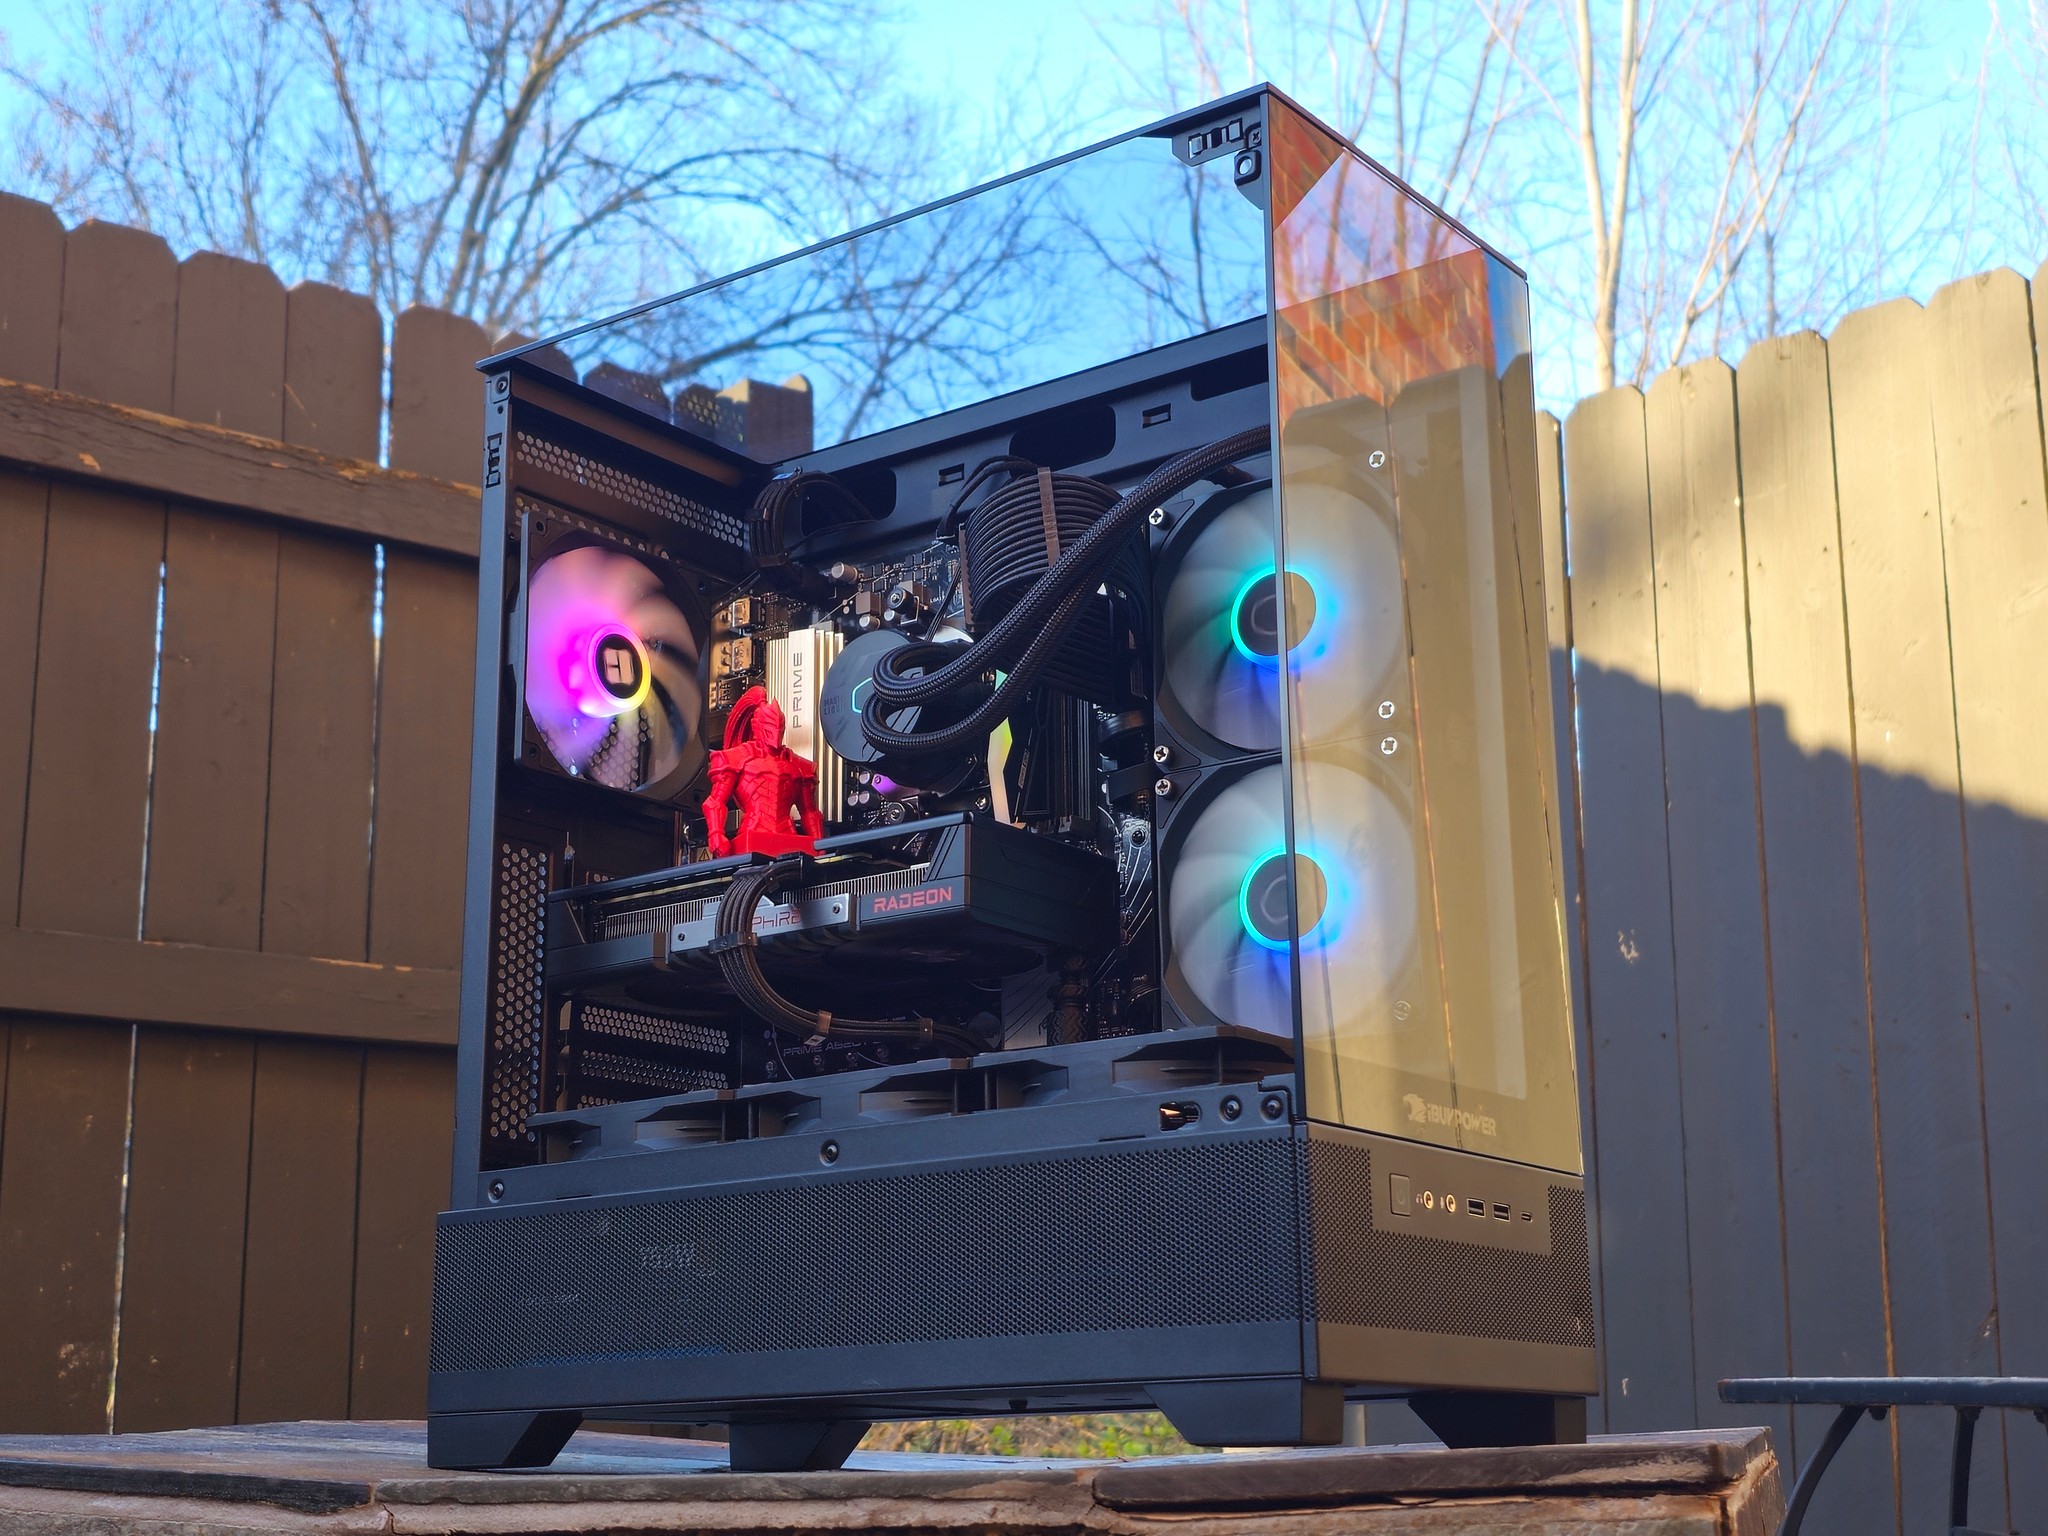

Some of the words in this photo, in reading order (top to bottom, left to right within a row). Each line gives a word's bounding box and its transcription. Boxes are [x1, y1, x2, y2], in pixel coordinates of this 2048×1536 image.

[792, 652, 803, 729] PRIME
[873, 886, 953, 914] RADEON
[783, 1043, 823, 1057] PRIME
